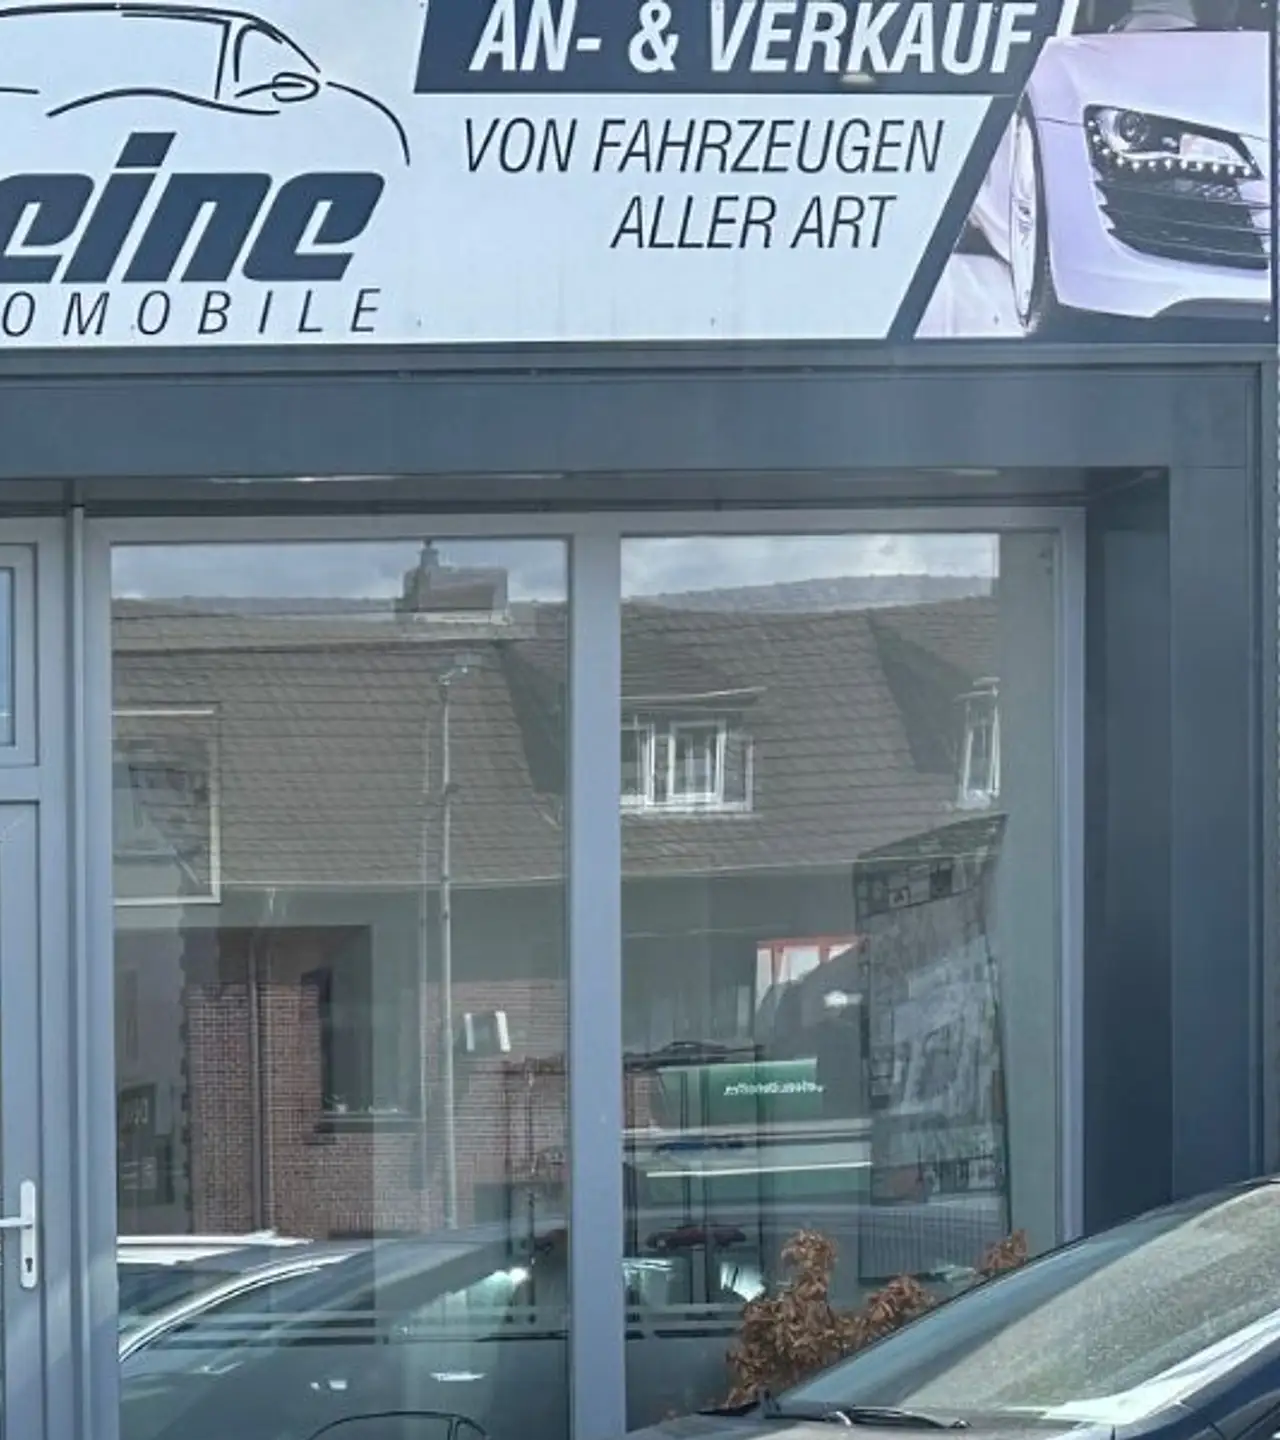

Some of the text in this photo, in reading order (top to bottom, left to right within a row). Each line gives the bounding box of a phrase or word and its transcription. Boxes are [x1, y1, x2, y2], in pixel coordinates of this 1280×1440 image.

[468, 0, 1038, 75] AN- & VERKAUF
[464, 117, 945, 174] VON FAHRZEUGEN
[610, 195, 896, 250] ALLER ART
